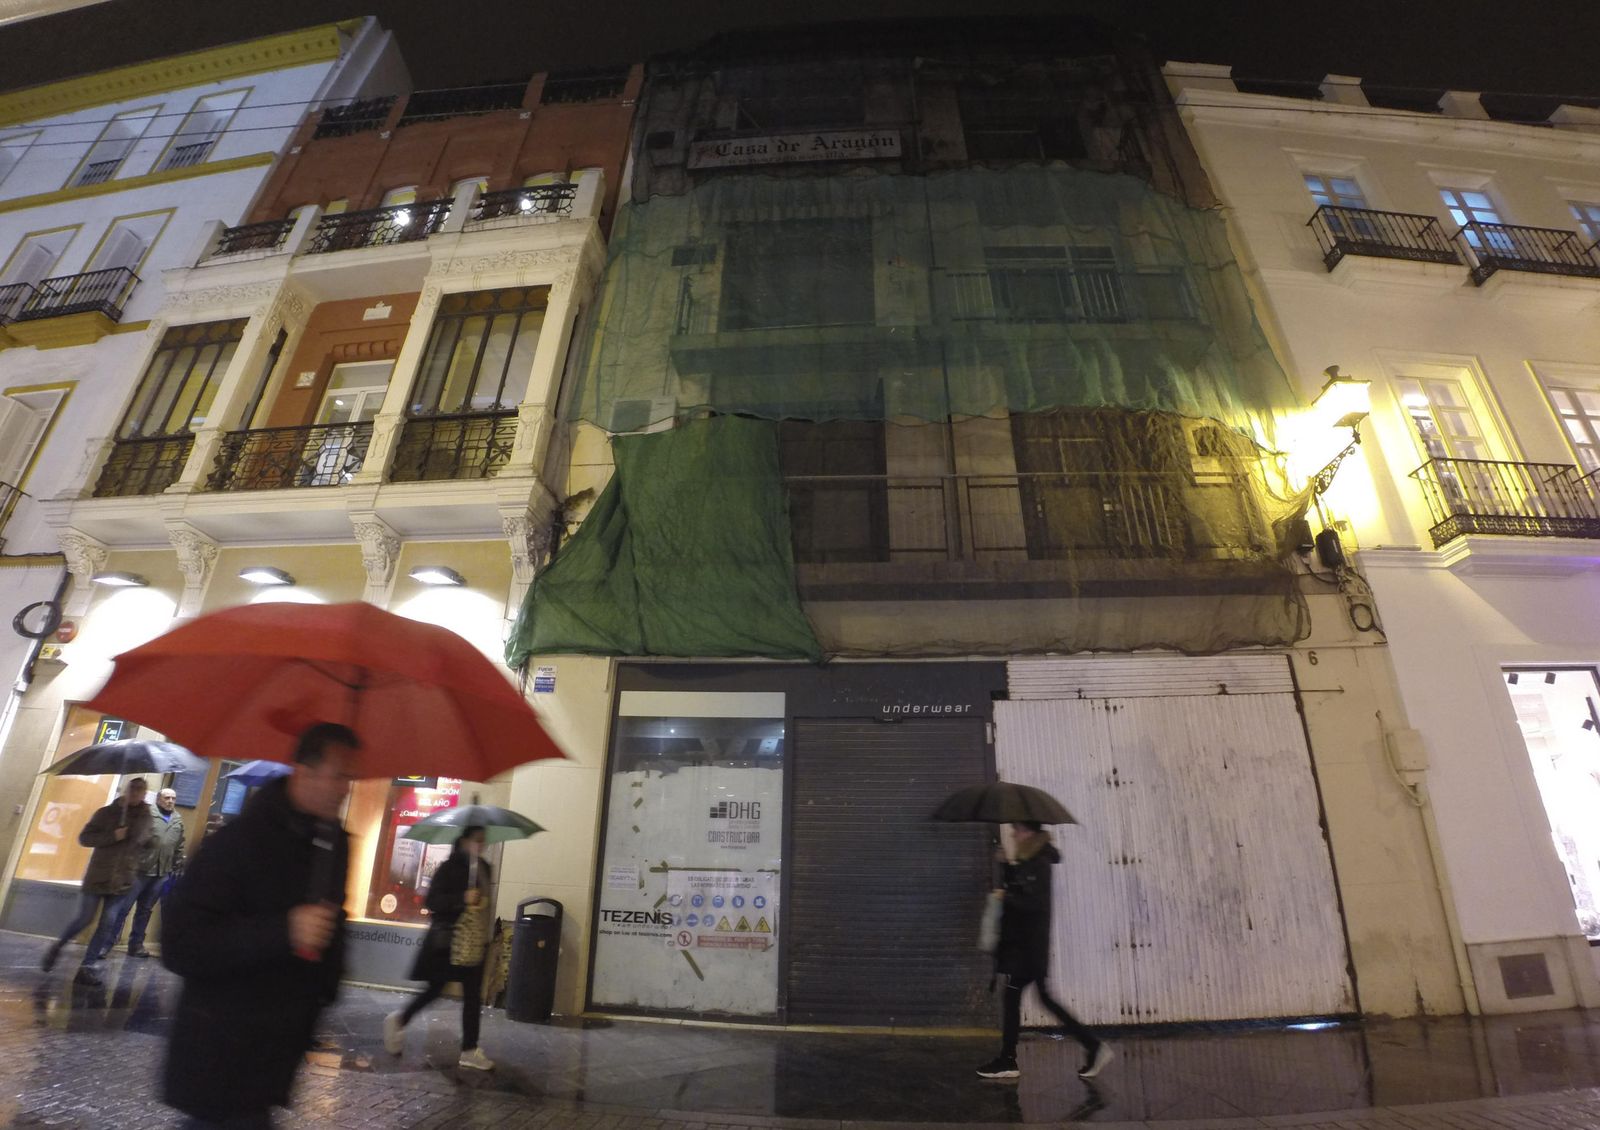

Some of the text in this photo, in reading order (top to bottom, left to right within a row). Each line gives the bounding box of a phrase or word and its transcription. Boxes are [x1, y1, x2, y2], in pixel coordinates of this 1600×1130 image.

[715, 134, 895, 157] Casa de Aragón
[1307, 650, 1318, 666] 6
[882, 703, 972, 714] underwear
[433, 798, 450, 807] AÑO
[729, 801, 761, 820] DHG
[708, 831, 761, 843] CONSTRUCTORA
[600, 909, 673, 925] TEZENIS
[348, 929, 425, 947] casadellibro.c
